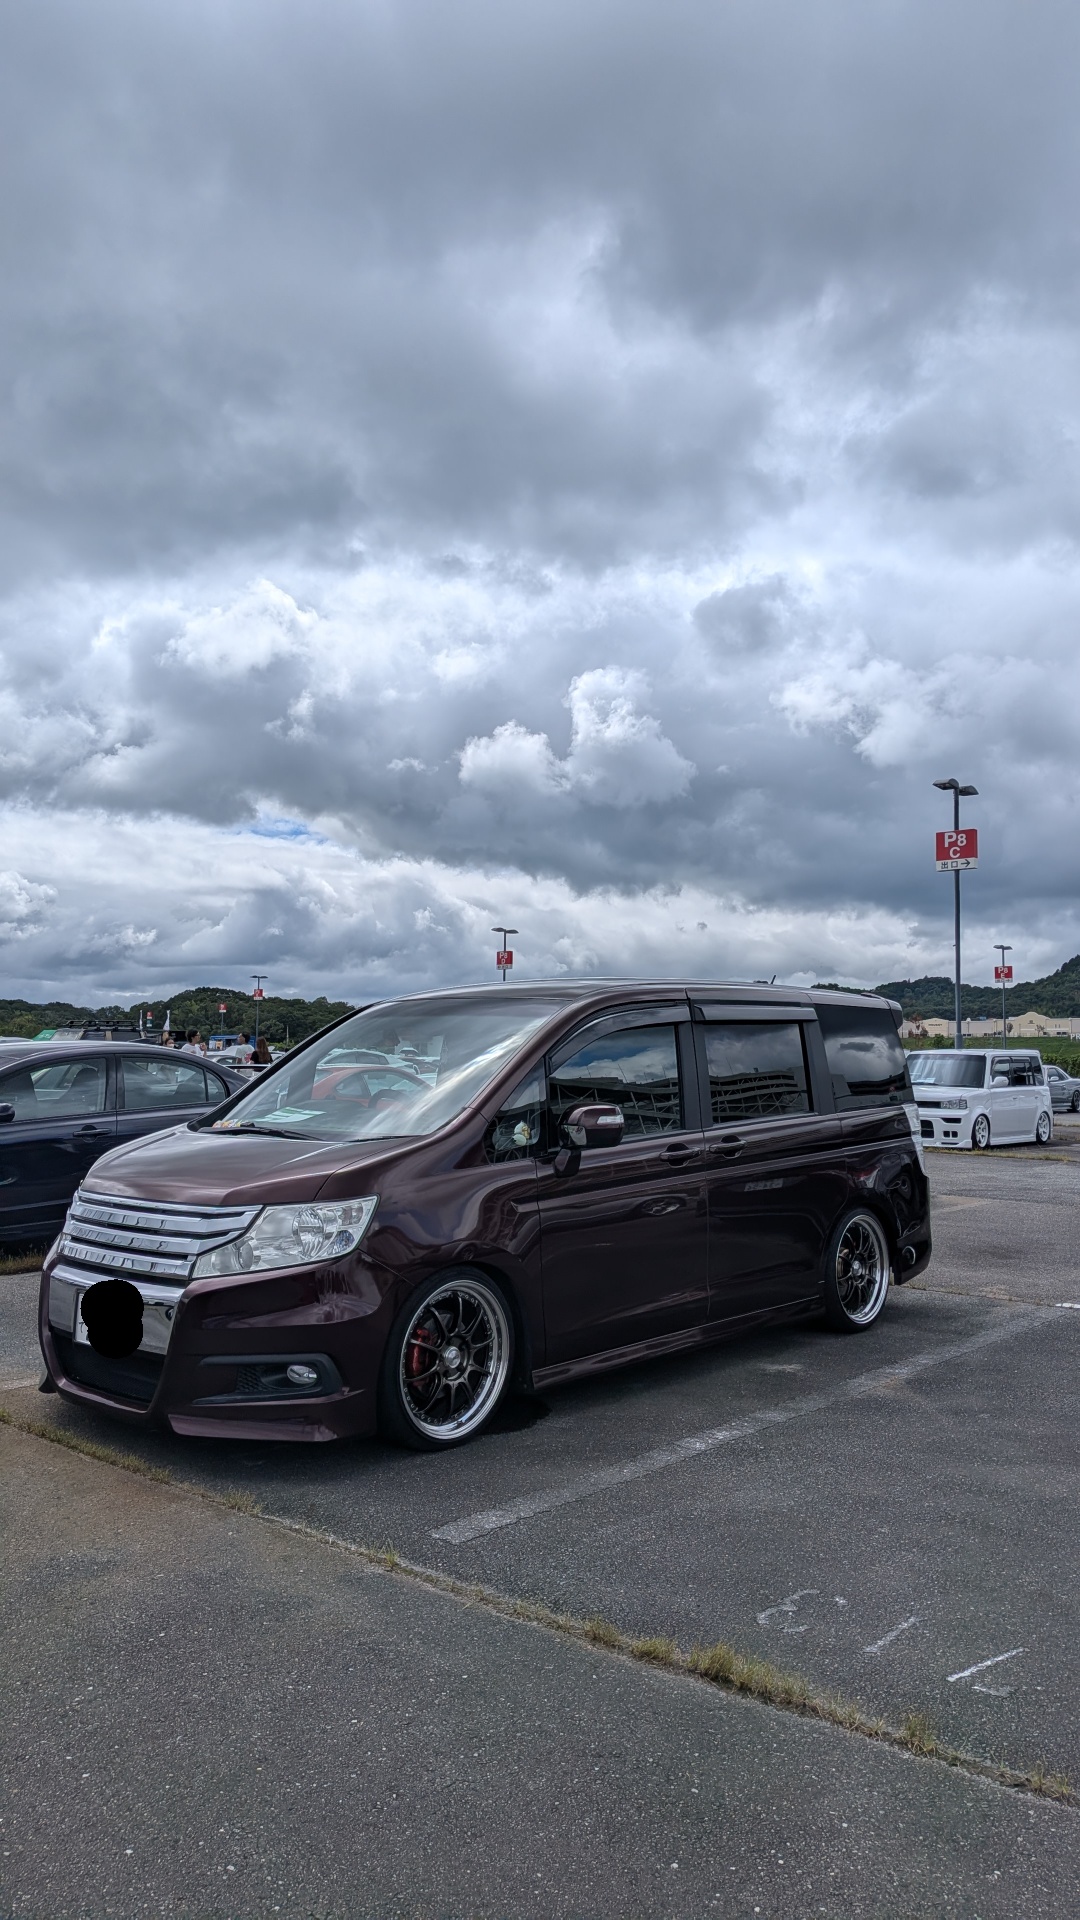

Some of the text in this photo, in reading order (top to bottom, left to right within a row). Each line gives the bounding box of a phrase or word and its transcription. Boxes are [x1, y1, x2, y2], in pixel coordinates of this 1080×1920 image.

[944, 832, 967, 848] P8
[949, 846, 961, 859] C
[940, 861, 959, 870] 出口
